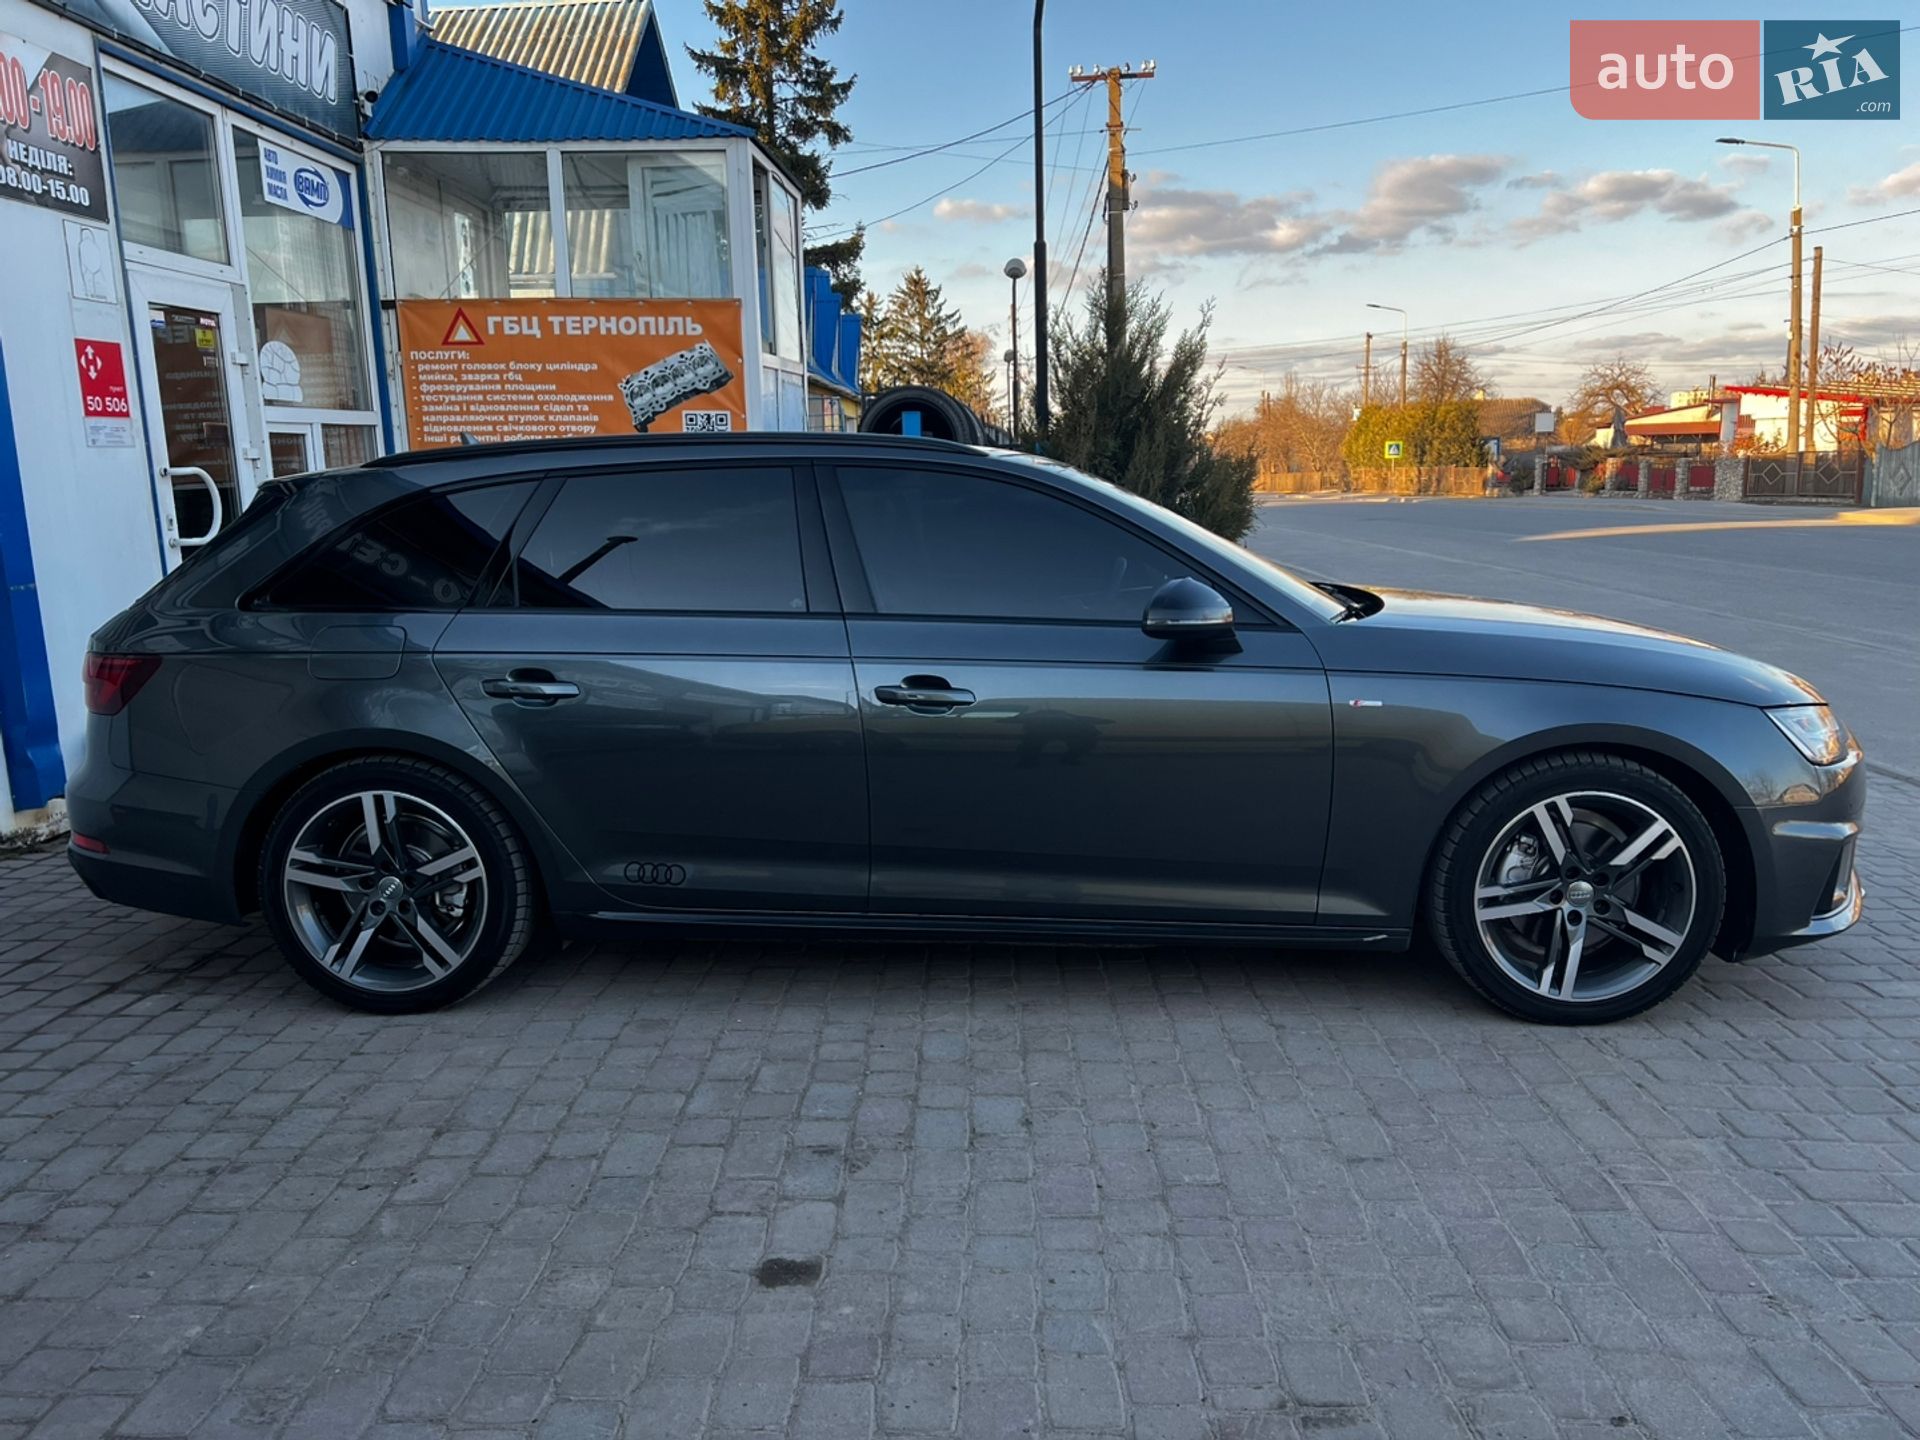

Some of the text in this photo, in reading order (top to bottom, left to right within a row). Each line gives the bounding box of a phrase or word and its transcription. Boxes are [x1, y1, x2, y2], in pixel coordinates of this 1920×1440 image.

[6, 138, 74, 177] НЕДІЛЯ:
[486, 315, 703, 338] ГБЦ ТЕРНОПІЛЬ
[410, 350, 470, 360] ПОСЛУГИ:
[417, 363, 458, 372] ремонт
[509, 361, 542, 371] блоку
[545, 362, 598, 372] циліндра
[502, 372, 523, 382] гбц
[504, 384, 556, 392] площини
[537, 394, 614, 402] охолодження
[86, 396, 128, 412] 50 506
[558, 424, 597, 433] отвору
